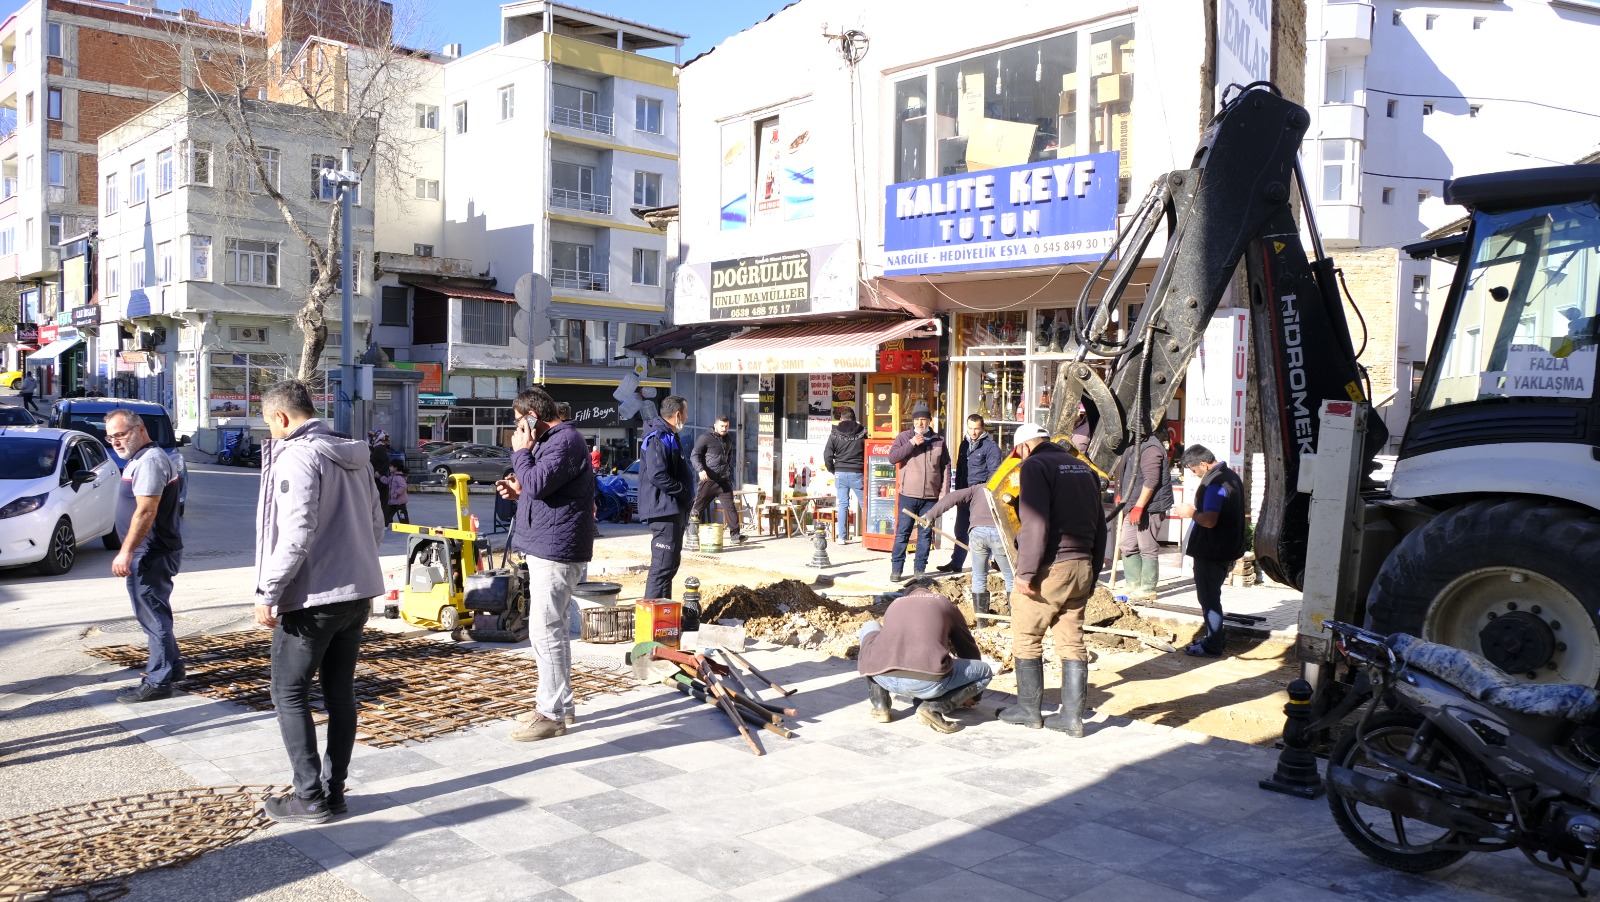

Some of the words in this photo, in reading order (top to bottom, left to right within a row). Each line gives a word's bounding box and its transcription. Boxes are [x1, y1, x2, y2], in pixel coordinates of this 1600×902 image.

[1009, 160, 1096, 206] KEYF
[939, 209, 1040, 243] TÜTÜN
[886, 252, 929, 267] NARGİLE
[939, 244, 996, 262] HEDİYELİK
[1000, 243, 1027, 259] EŞYA
[1033, 244, 1040, 254] 0
[1043, 241, 1060, 252] 545
[1063, 239, 1082, 251] 849
[1085, 238, 1098, 249] 30
[713, 258, 809, 289] DOĞRULUK
[714, 294, 741, 307] UNLU
[743, 287, 806, 303] MAMÜLLER
[768, 305, 778, 315] 75
[780, 304, 791, 314] 17
[1530, 357, 1569, 371] FAZLA
[1513, 375, 1585, 394] YAKLAŞMA
[575, 408, 591, 421] Filli
[592, 406, 616, 419] Boya
[1187, 416, 1230, 425] MAKARON
